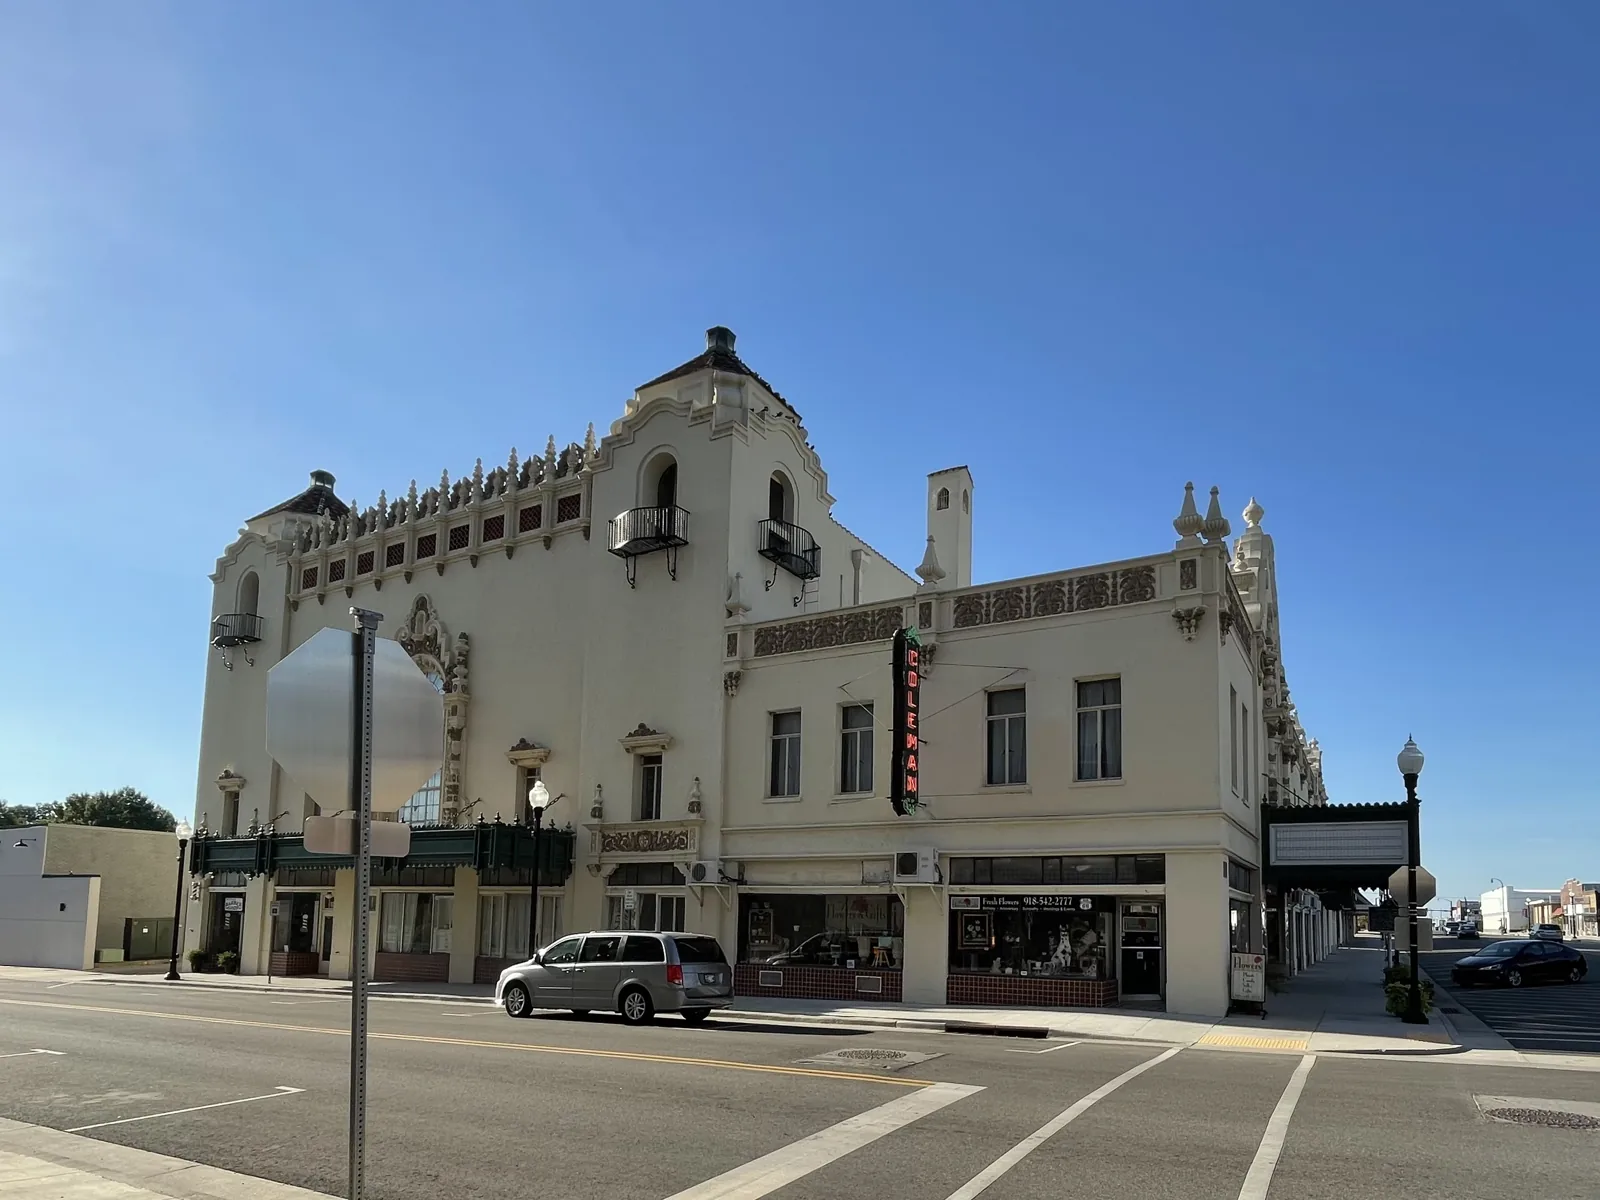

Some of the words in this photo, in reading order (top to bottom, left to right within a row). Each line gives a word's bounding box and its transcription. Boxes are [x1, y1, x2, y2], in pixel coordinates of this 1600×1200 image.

[906, 649, 918, 793] COLEMAN
[982, 896, 998, 905] Fresh
[998, 896, 1020, 906] Flowers
[1023, 896, 1073, 906] 918-542-2777
[1233, 956, 1262, 970] Flowers
